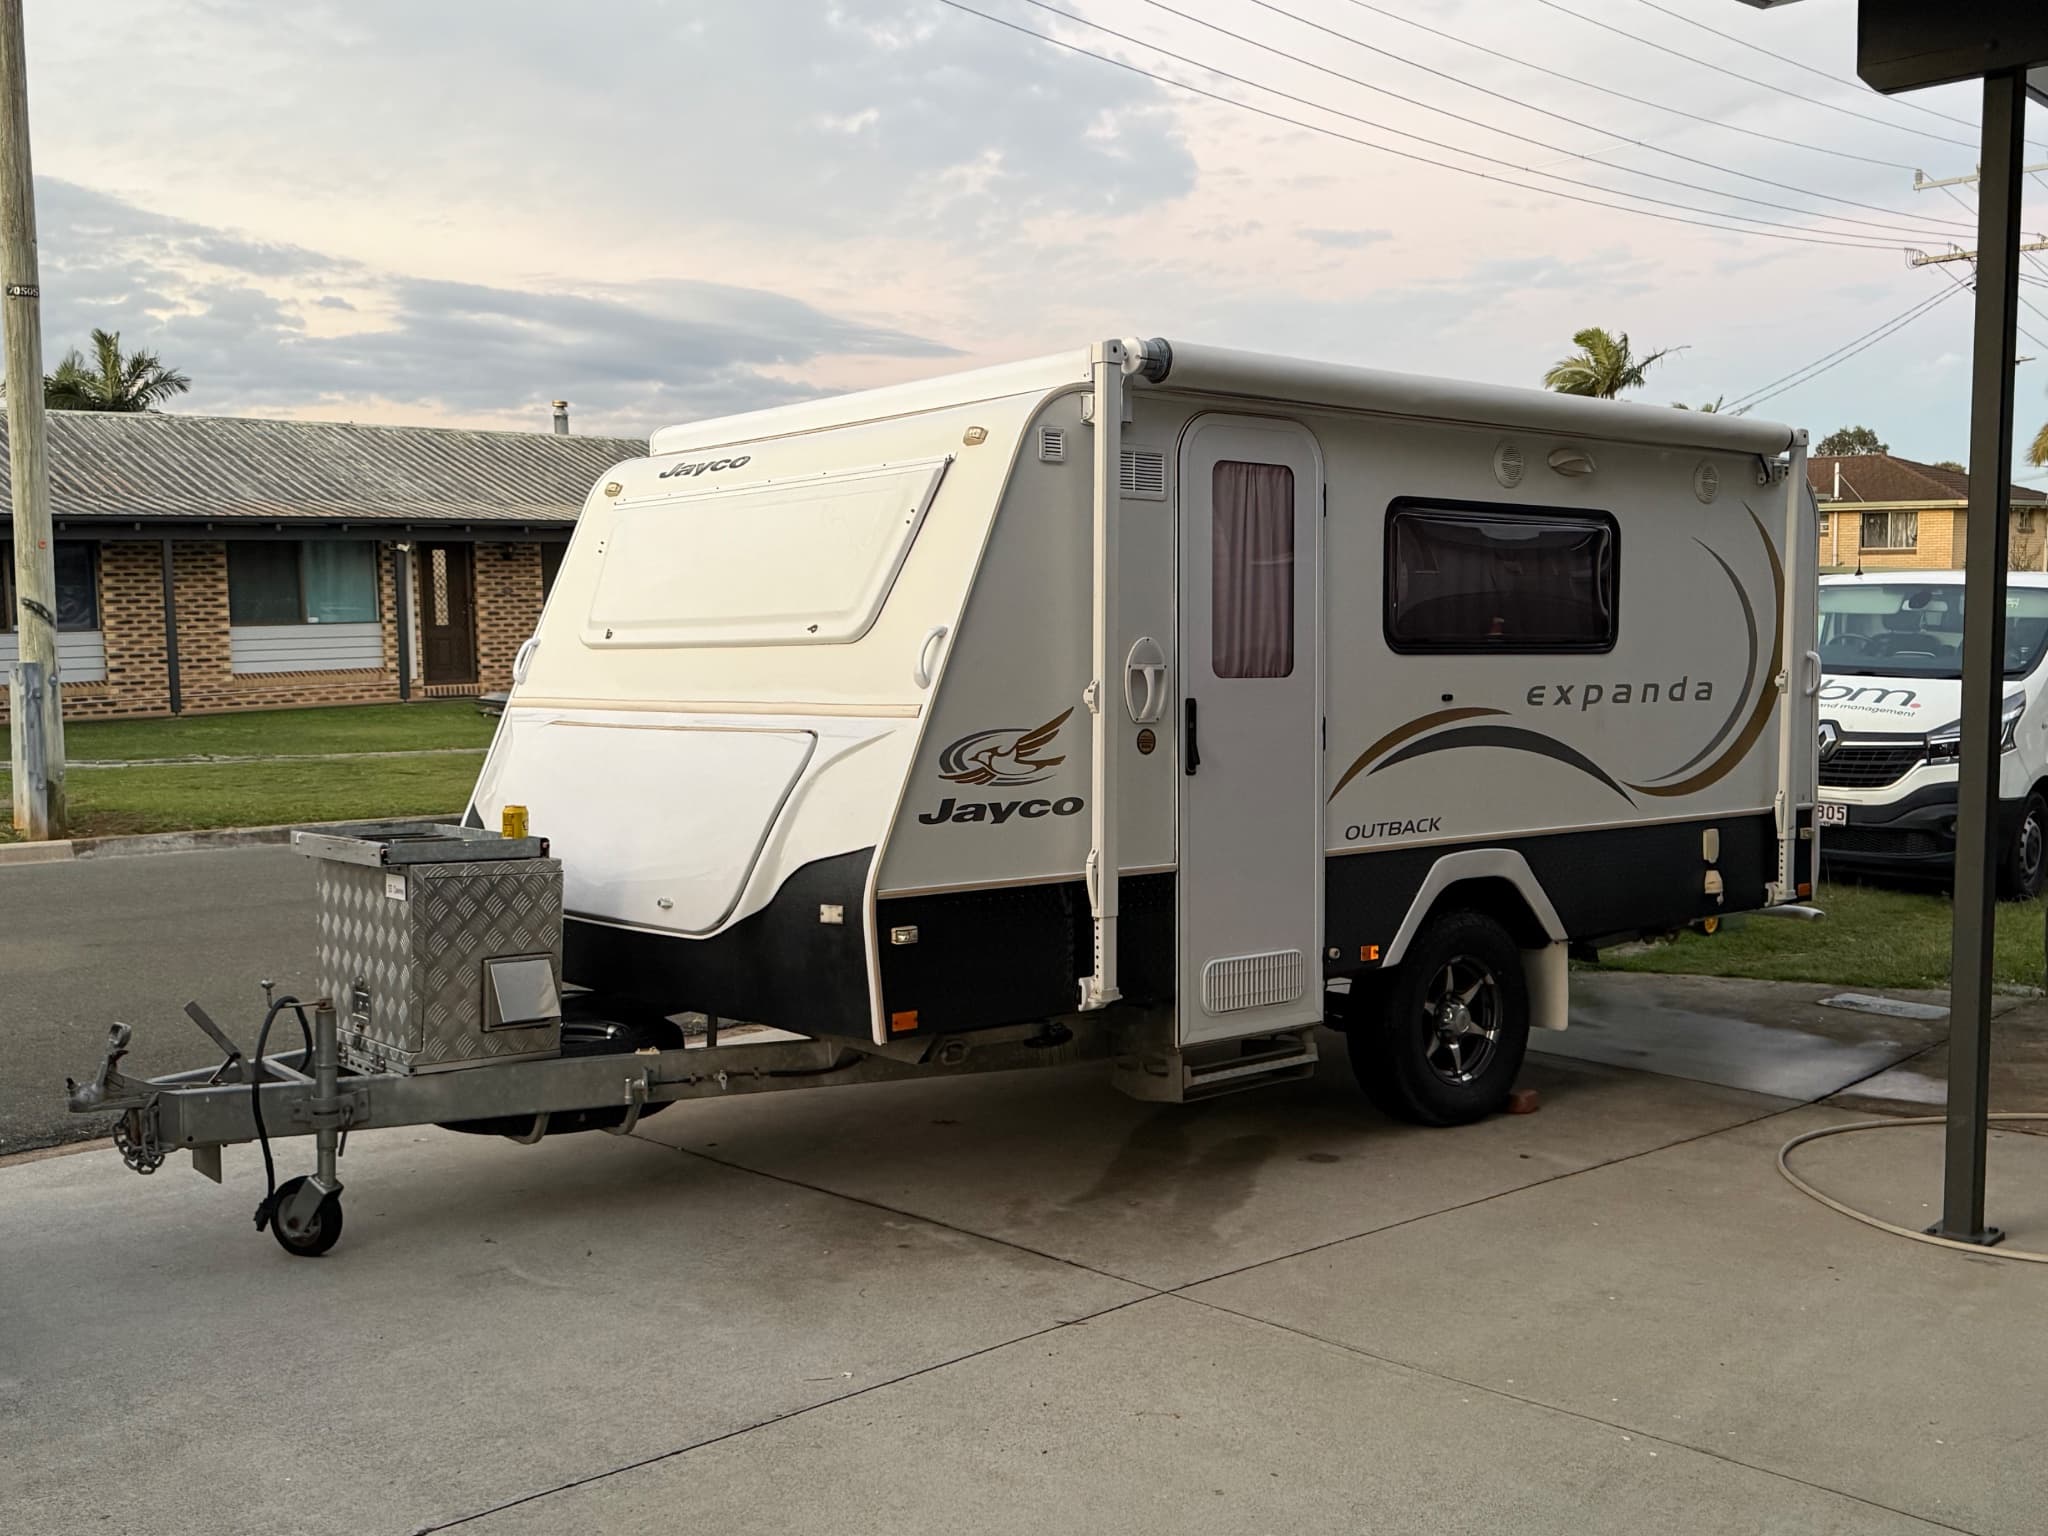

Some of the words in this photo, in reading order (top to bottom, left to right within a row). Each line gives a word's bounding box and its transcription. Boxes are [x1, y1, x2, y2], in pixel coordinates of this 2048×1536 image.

[659, 455, 752, 478] Jayco
[1526, 675, 1713, 712] expanda
[1840, 703, 1916, 717] management
[918, 796, 1085, 825] Jayco
[1345, 816, 1442, 841] OUTBACK
